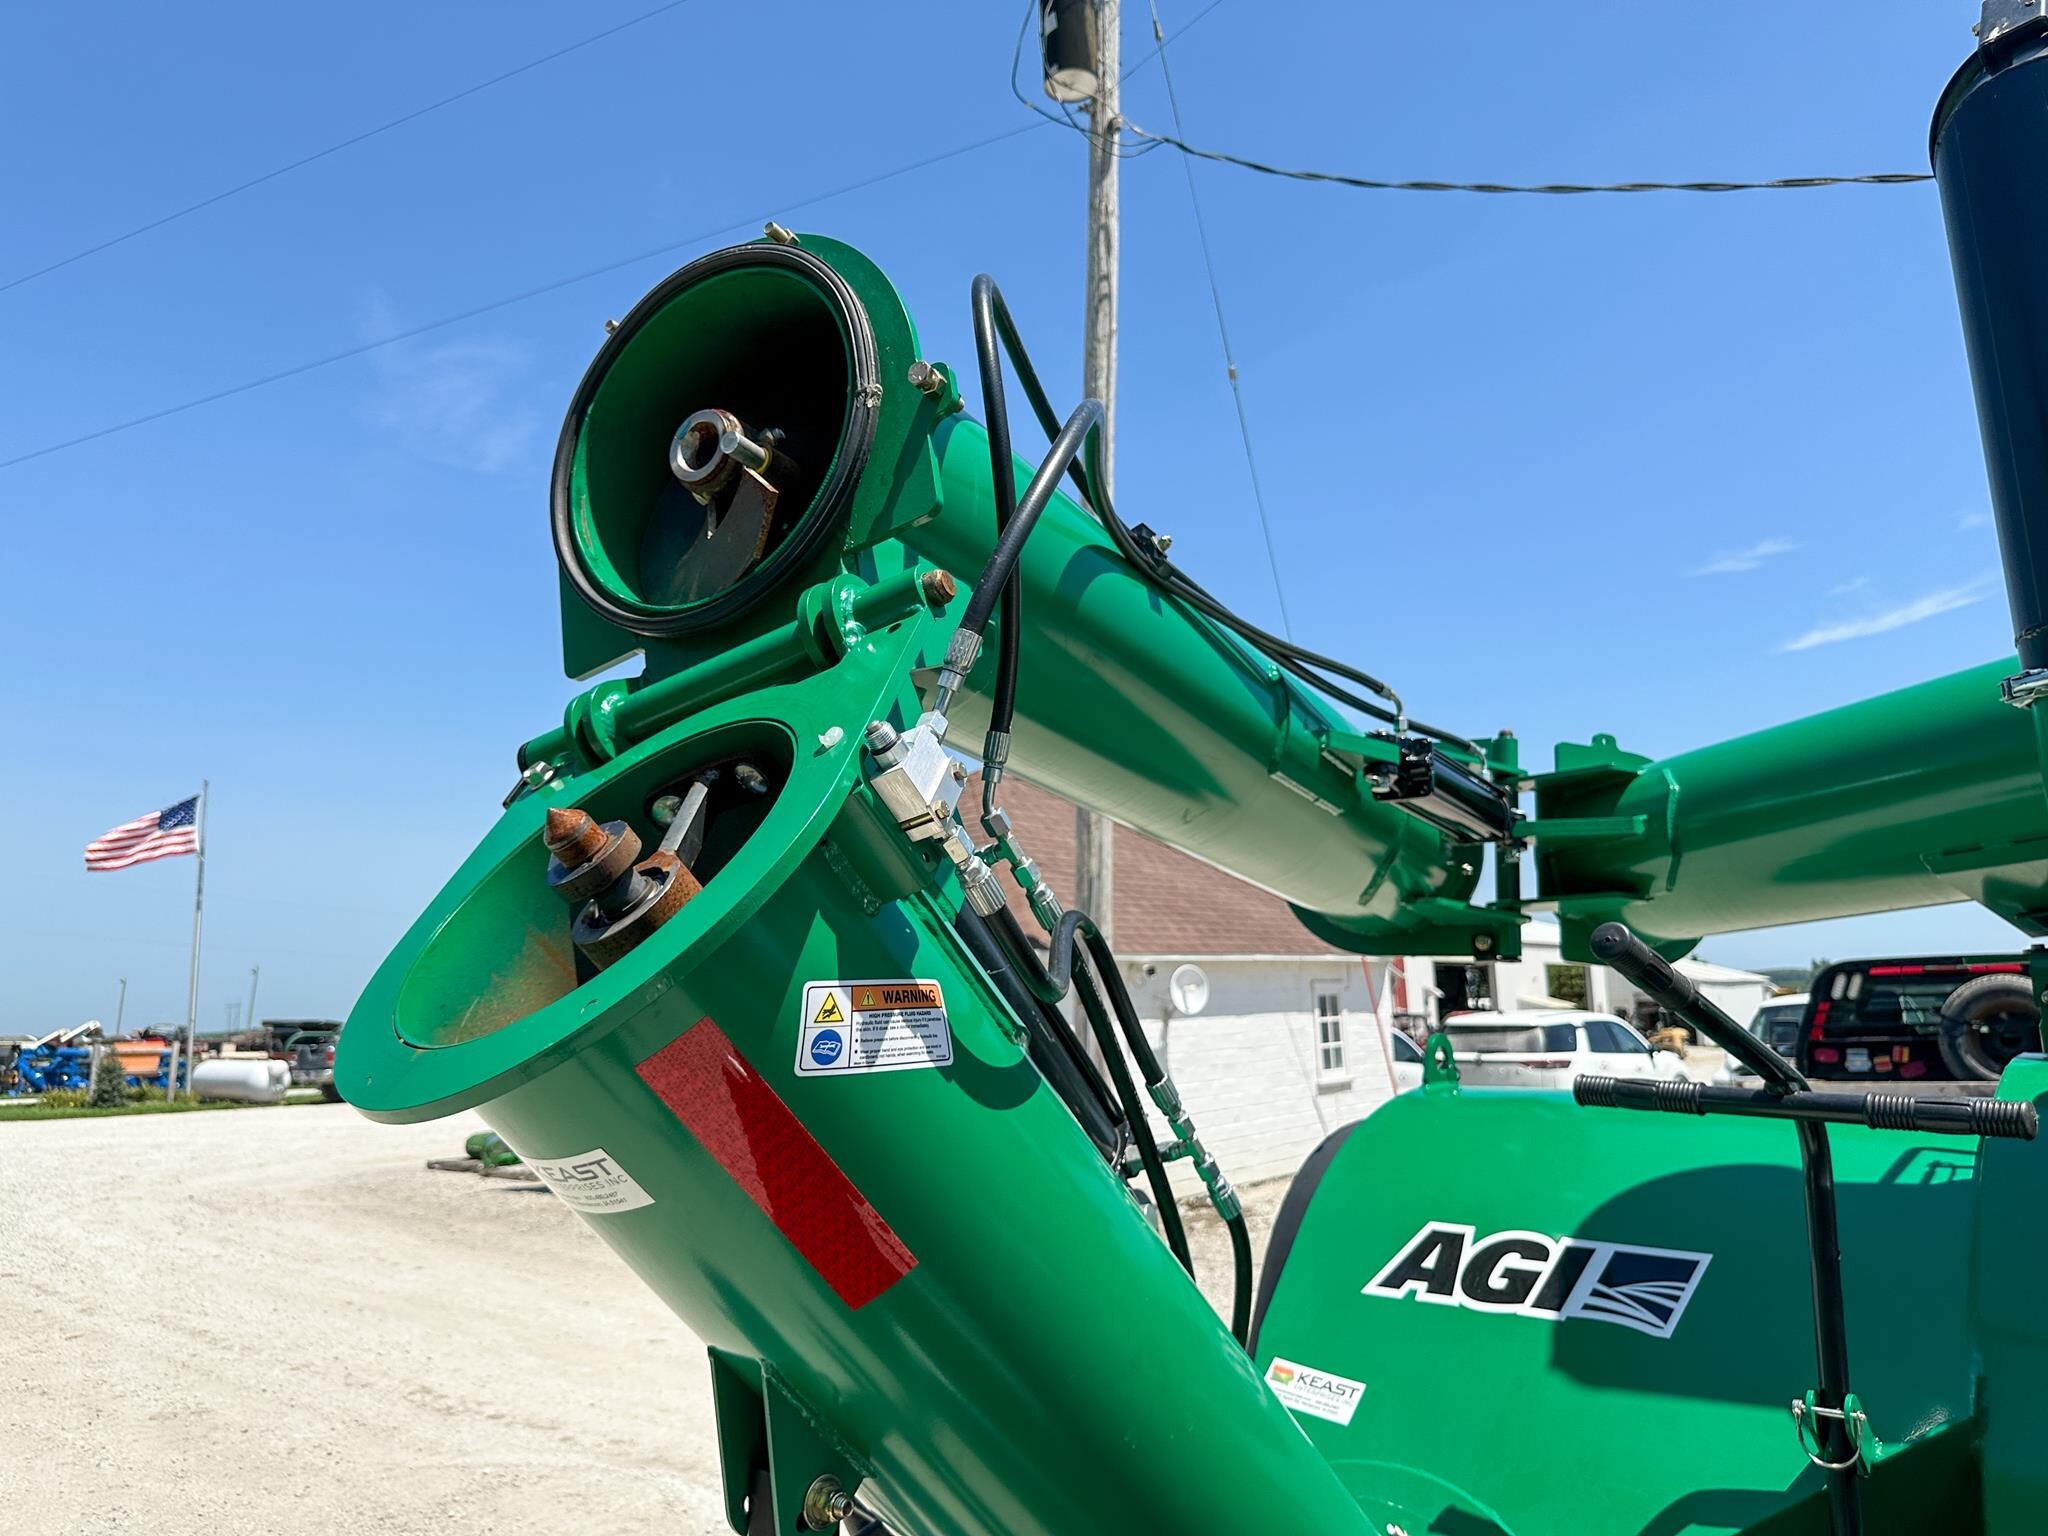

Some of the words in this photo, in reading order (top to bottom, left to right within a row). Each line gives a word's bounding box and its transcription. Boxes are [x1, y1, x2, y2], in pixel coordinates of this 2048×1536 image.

[882, 990, 936, 1004] WARNING
[1375, 1229, 1597, 1313] AGI
[1296, 1372, 1360, 1399] KEAST
